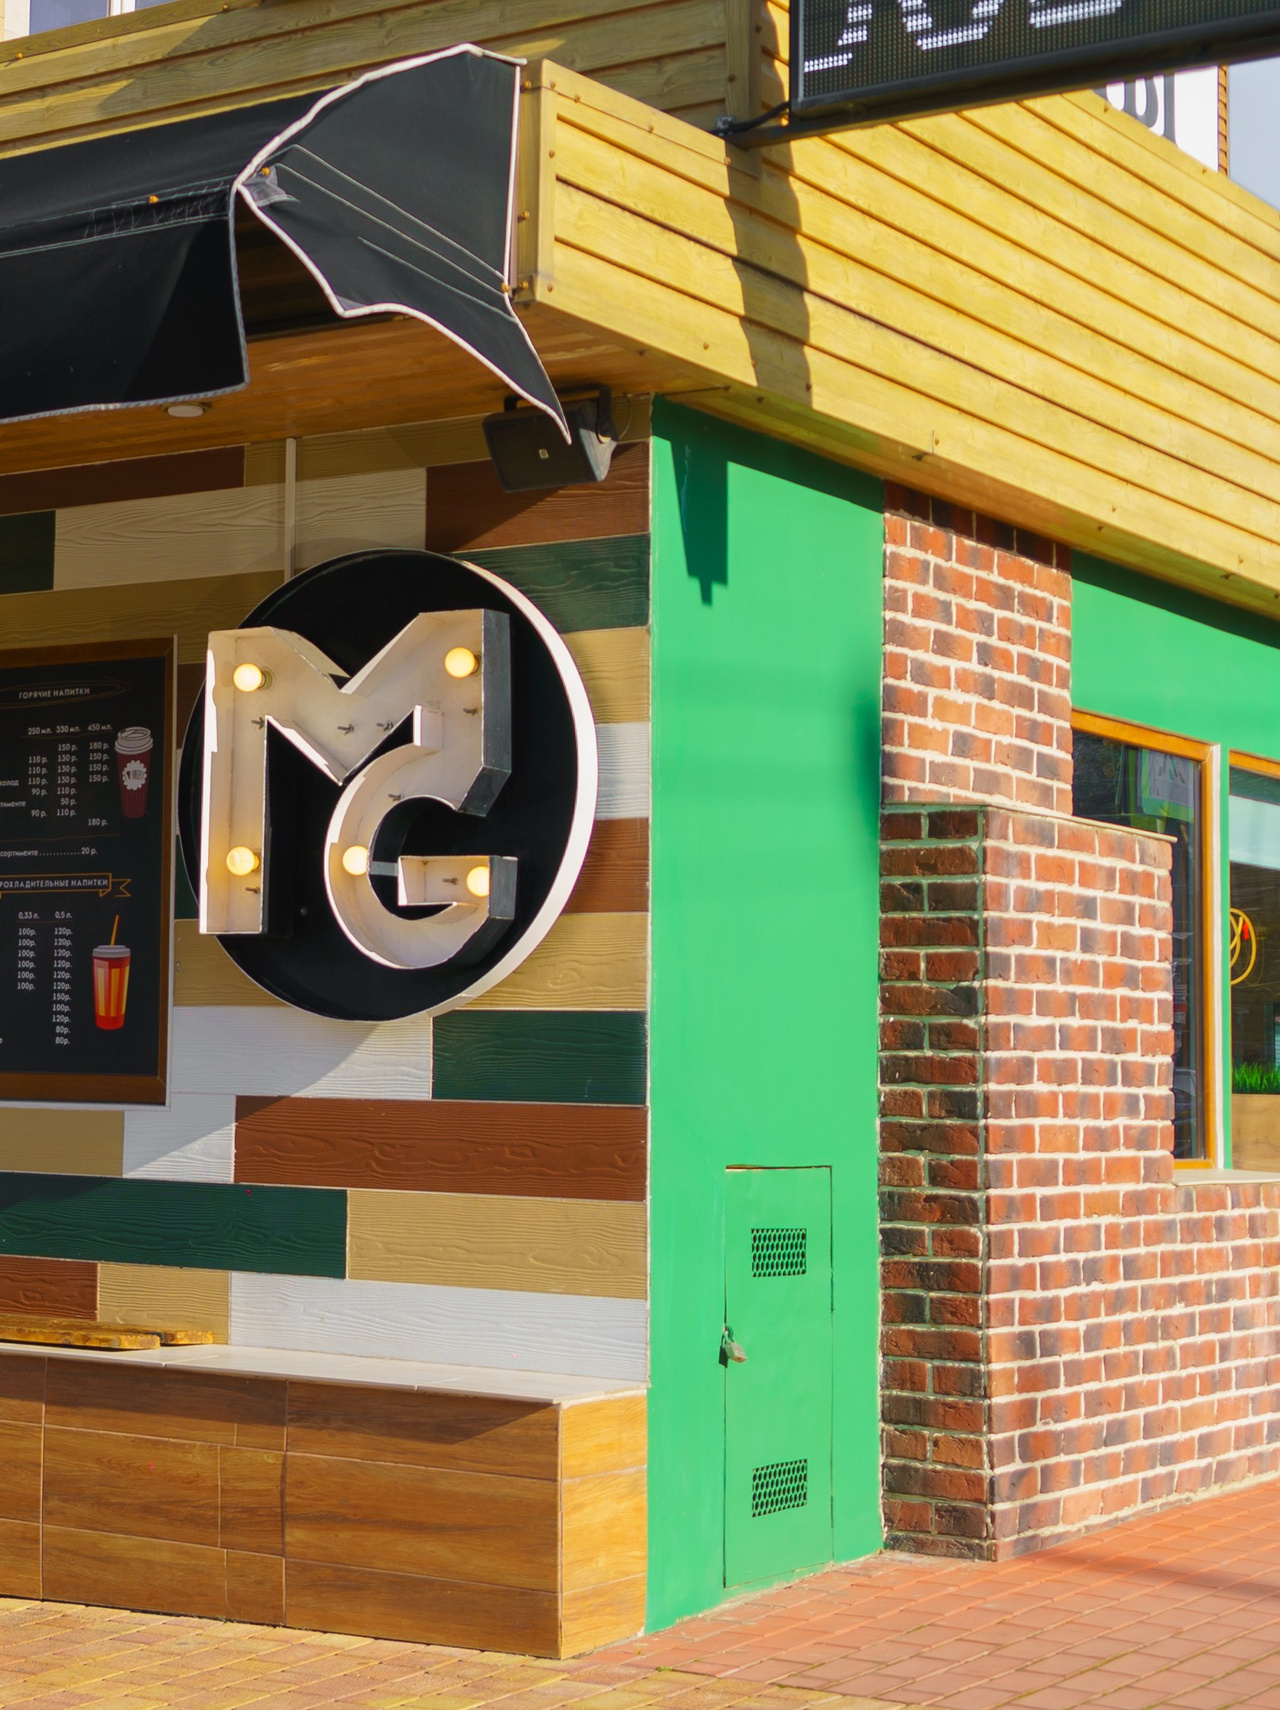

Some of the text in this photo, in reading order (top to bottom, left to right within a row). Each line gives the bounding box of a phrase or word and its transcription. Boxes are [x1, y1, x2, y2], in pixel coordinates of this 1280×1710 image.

[19, 688, 90, 699] ГОРЯЧИЕ НАПИТКИ
[28, 727, 40, 735] 250
[88, 723, 100, 731] 450
[58, 743, 70, 751] 150
[29, 755, 41, 763] 110
[29, 766, 40, 774] 110
[28, 777, 40, 785] 110
[89, 774, 101, 782] 150
[57, 787, 70, 795] 110
[31, 809, 40, 817] 90
[81, 847, 90, 855] 20
[71, 879, 108, 887] НАПИТКИ
[18, 911, 32, 919] 0,33
[55, 911, 65, 919] 0,5
